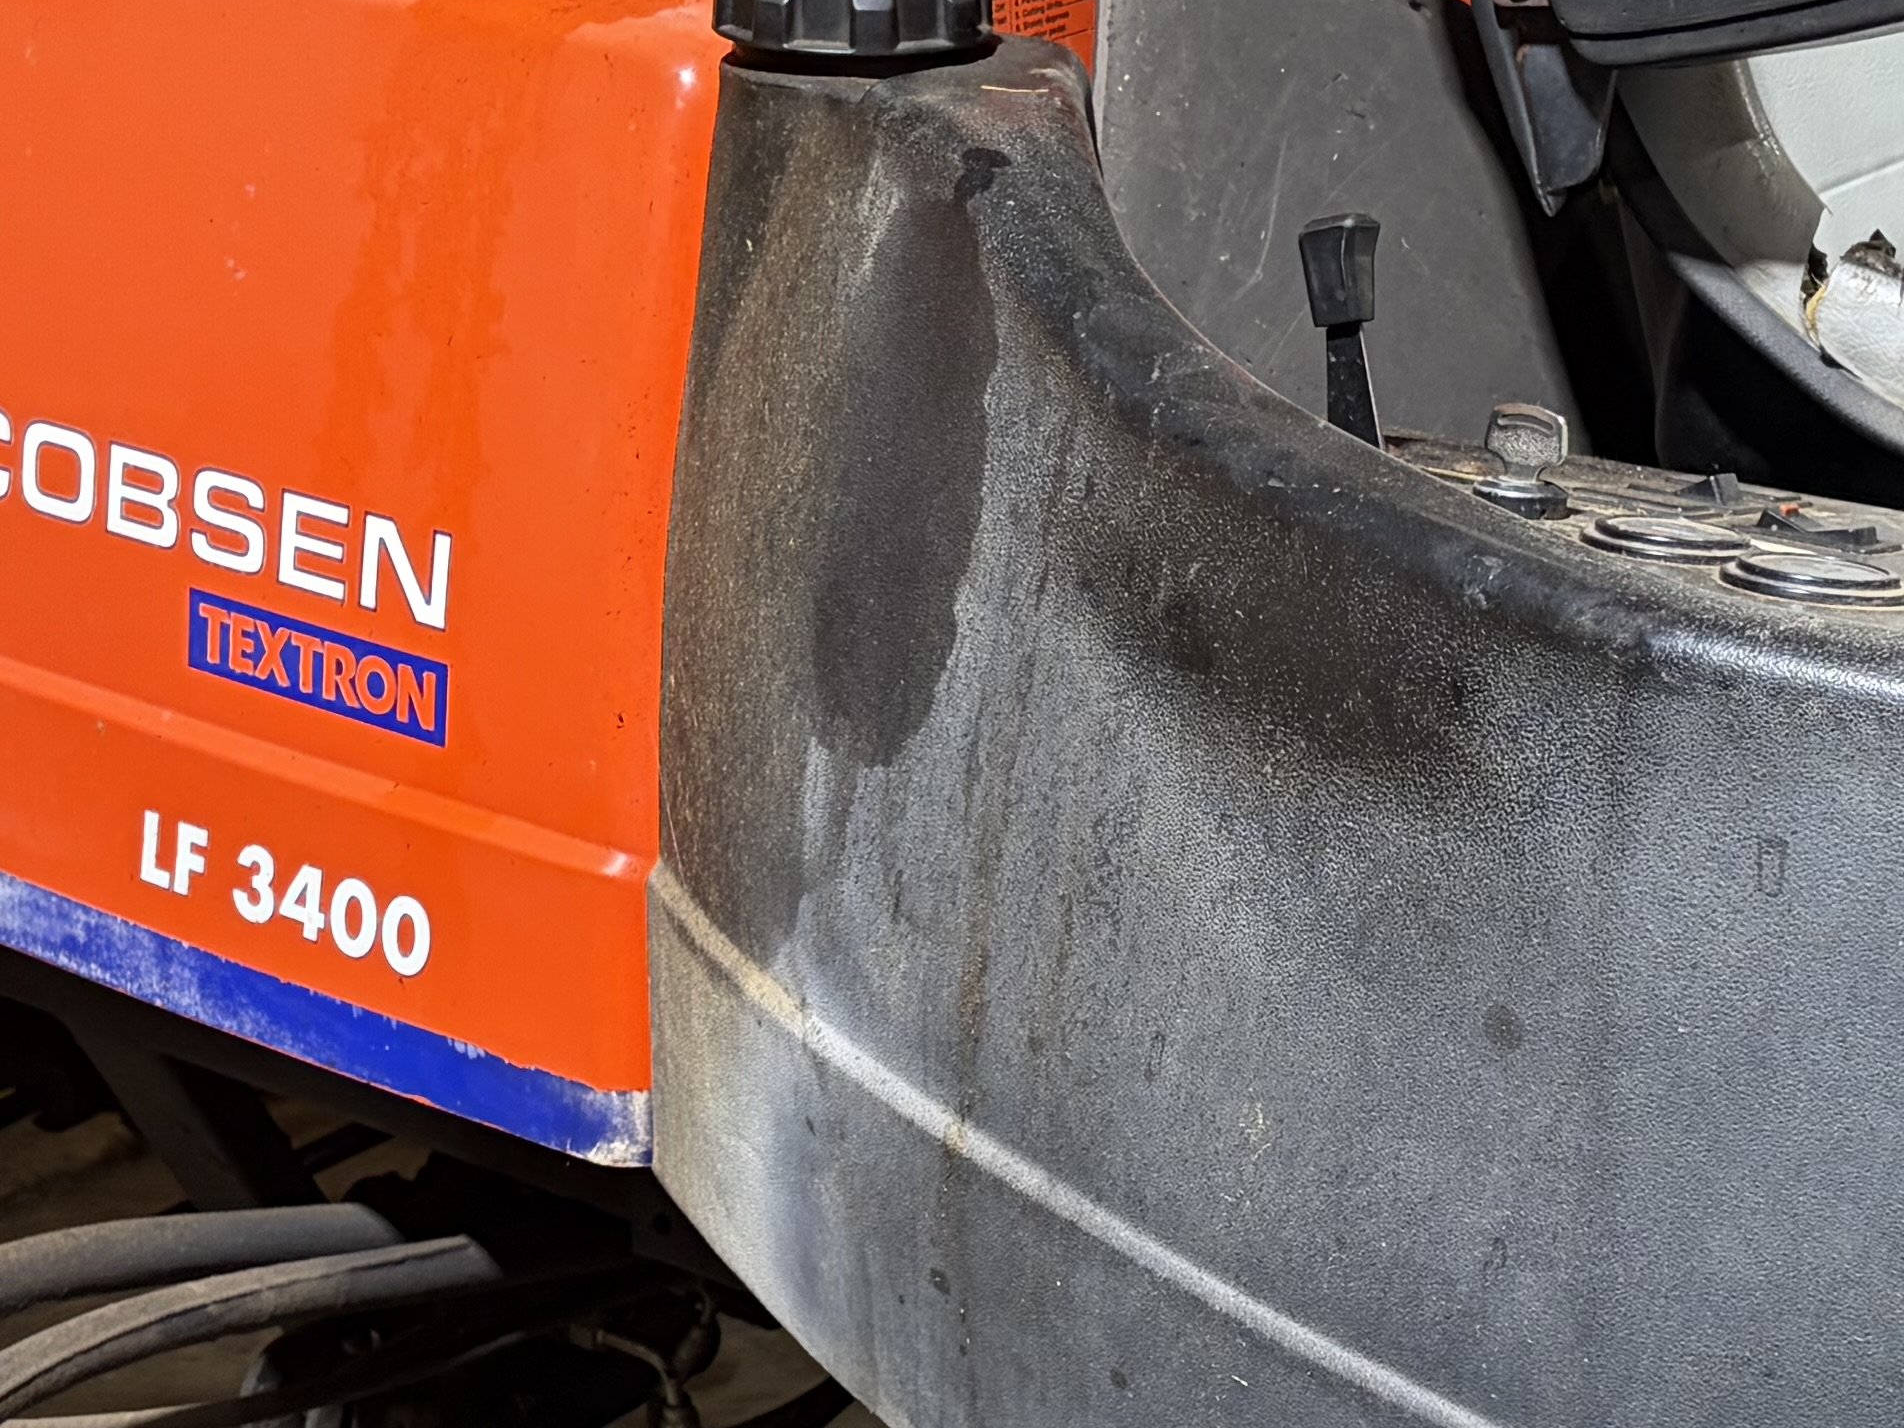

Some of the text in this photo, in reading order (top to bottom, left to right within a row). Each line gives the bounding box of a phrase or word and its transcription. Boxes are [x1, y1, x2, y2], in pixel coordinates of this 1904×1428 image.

[198, 602, 438, 732] TEXTRON
[139, 808, 432, 978] LF 3400
